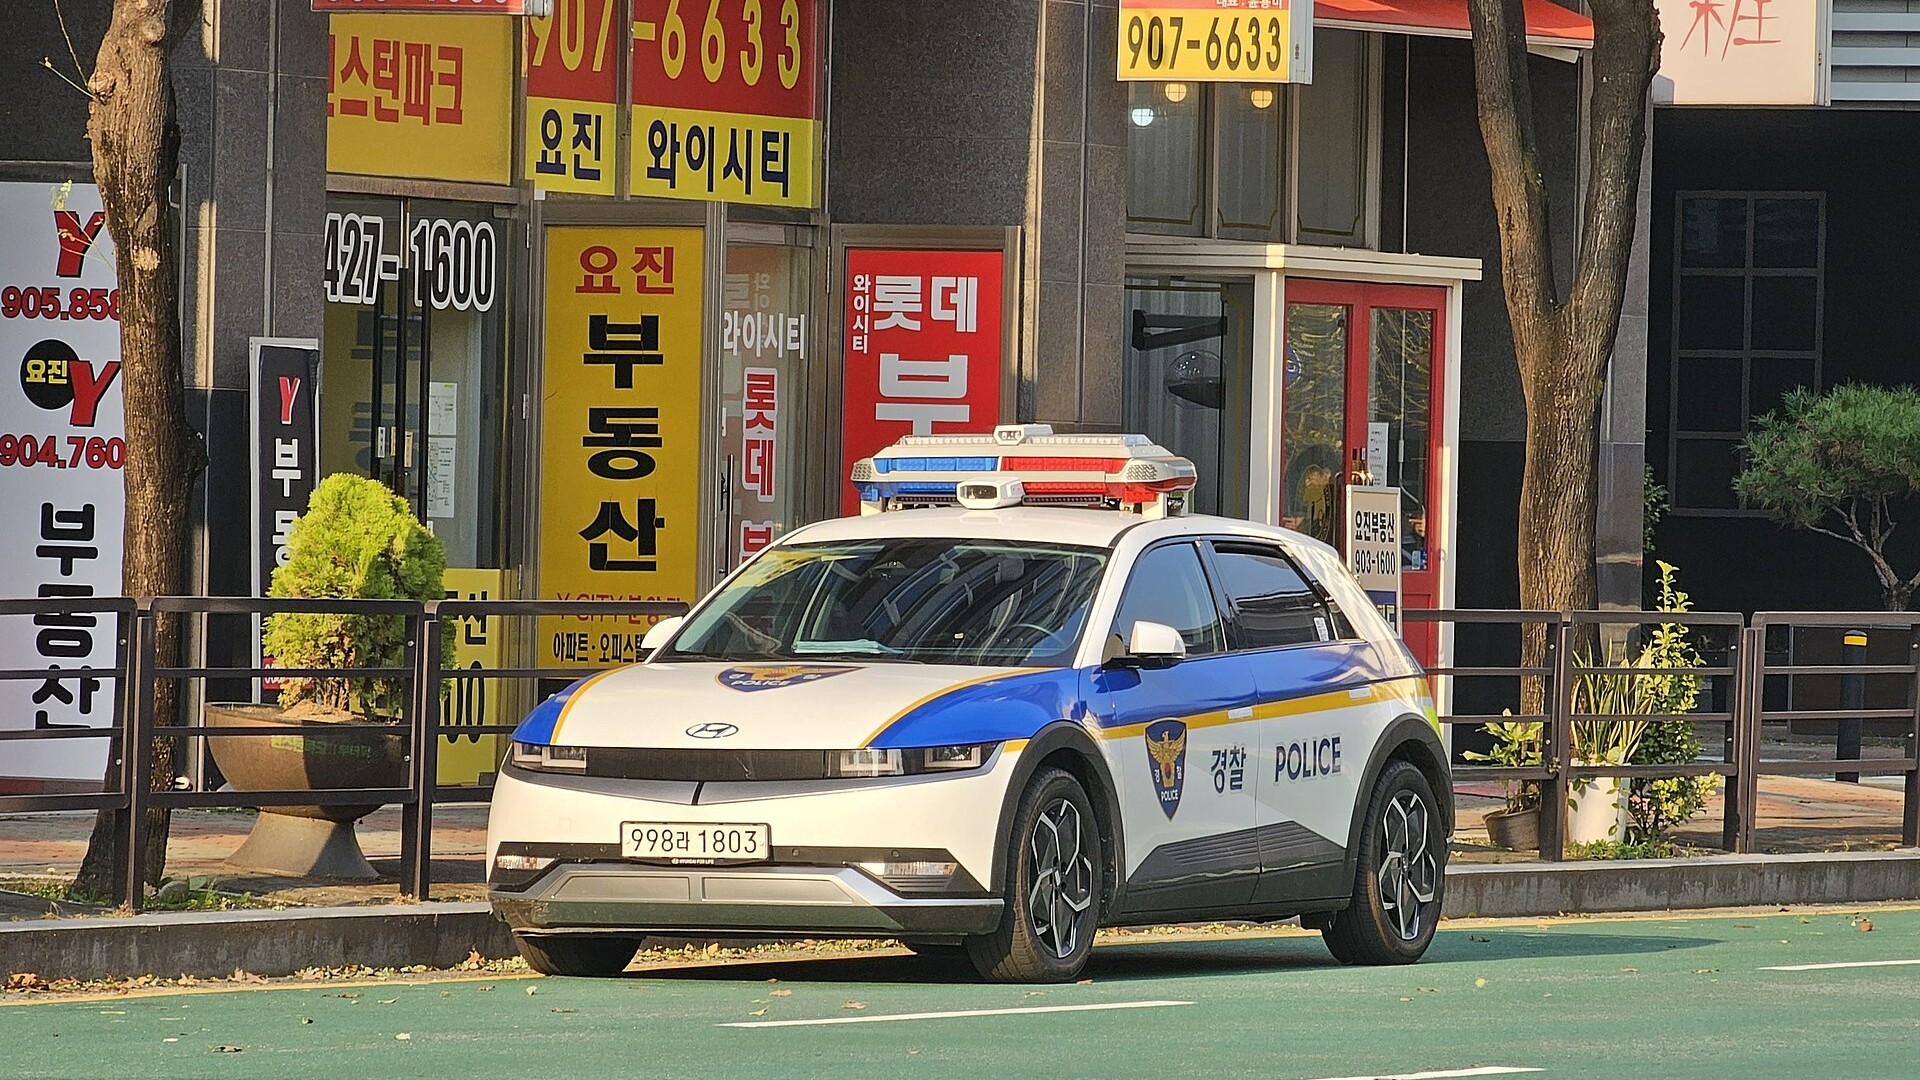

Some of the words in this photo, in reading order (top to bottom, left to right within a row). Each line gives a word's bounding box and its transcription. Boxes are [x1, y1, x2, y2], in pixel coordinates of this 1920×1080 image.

[1127, 16, 1282, 71] 907-6633
[327, 34, 463, 125] 스턴파크
[535, 108, 601, 181] 요진
[647, 119, 790, 198] 와이시티
[54, 210, 108, 278] Y
[575, 245, 676, 295] 요진
[851, 274, 871, 354] 와이시티
[873, 275, 978, 333] 롯데
[26, 359, 68, 384] 요진
[69, 361, 121, 427] Y
[278, 376, 300, 424] Y
[0, 433, 125, 469] 904.760
[577, 314, 666, 572] 부동산
[742, 368, 778, 502] 롯데
[1355, 510, 1395, 543] 요진부동산
[1355, 549, 1396, 575] 903-1600
[32, 502, 100, 730] 부동산
[1211, 746, 1247, 794] 경찰
[1275, 736, 1341, 782] POLICE
[1160, 790, 1179, 802] POLICE
[631, 828, 690, 852] 998라
[698, 829, 757, 853] 1803
